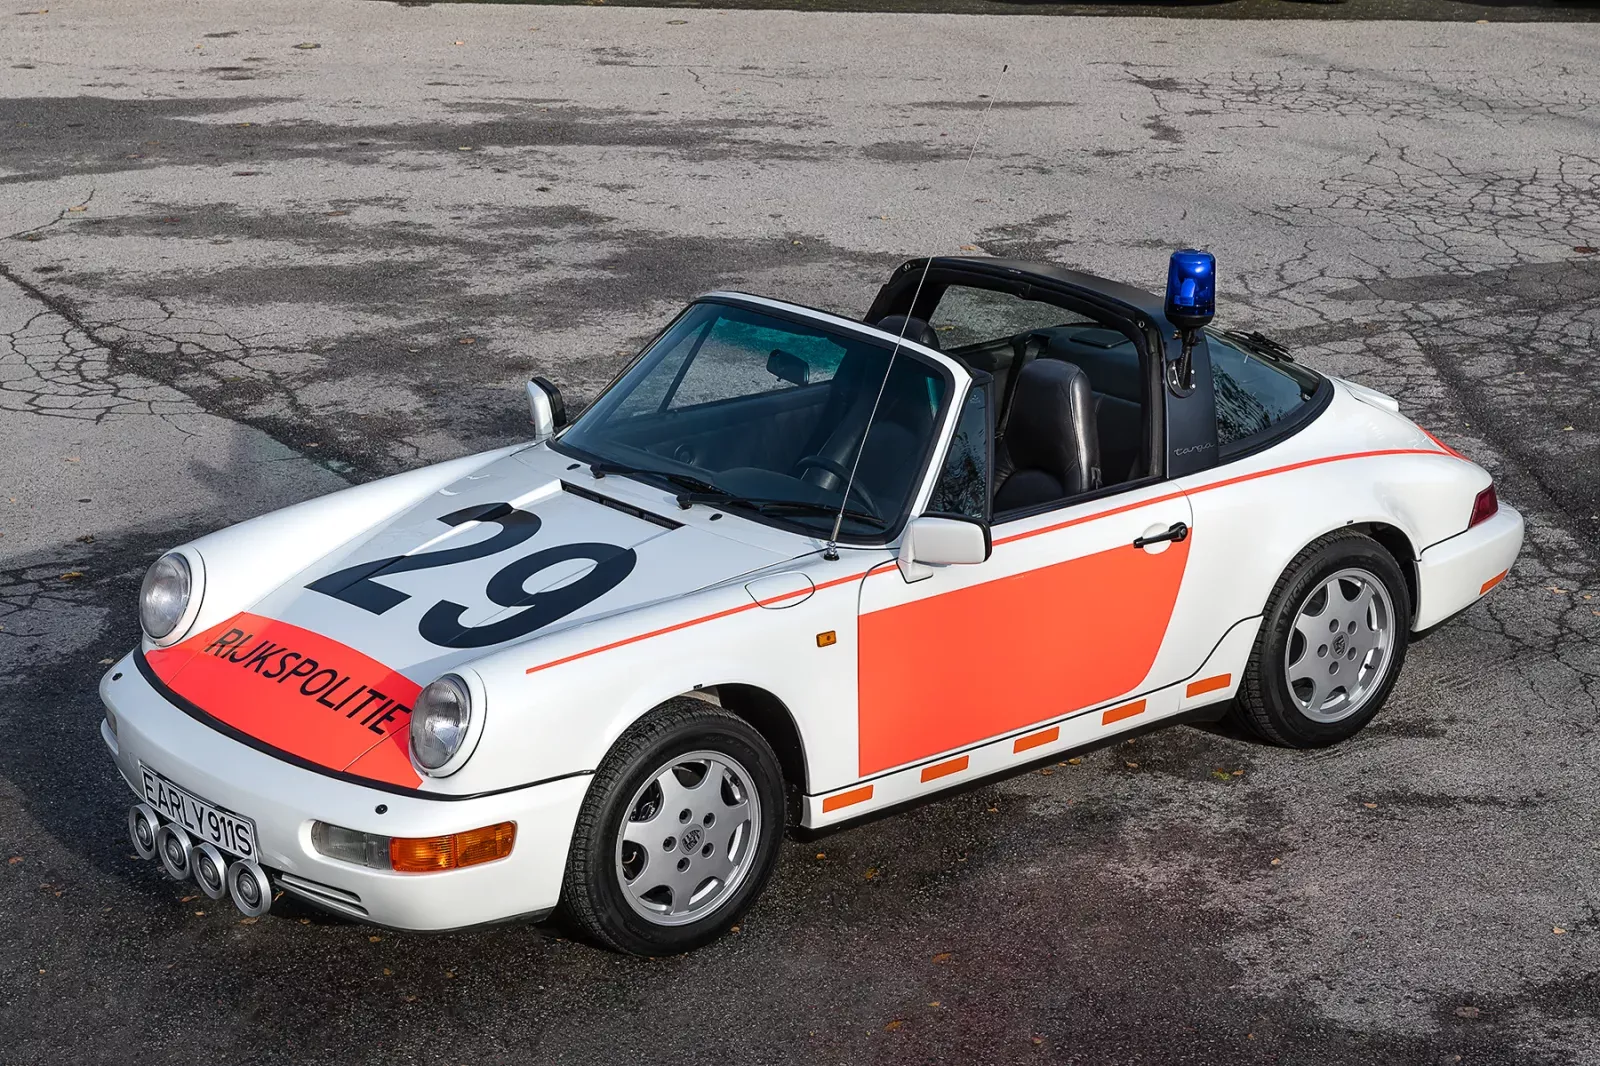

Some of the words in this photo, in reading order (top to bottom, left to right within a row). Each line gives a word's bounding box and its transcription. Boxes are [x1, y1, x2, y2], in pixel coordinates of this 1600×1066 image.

[1173, 442, 1215, 456] targa
[304, 502, 637, 649] 29
[204, 628, 412, 736] RIJKSPOLITIE
[142, 770, 206, 835] EARLY
[207, 811, 253, 856] 911S
